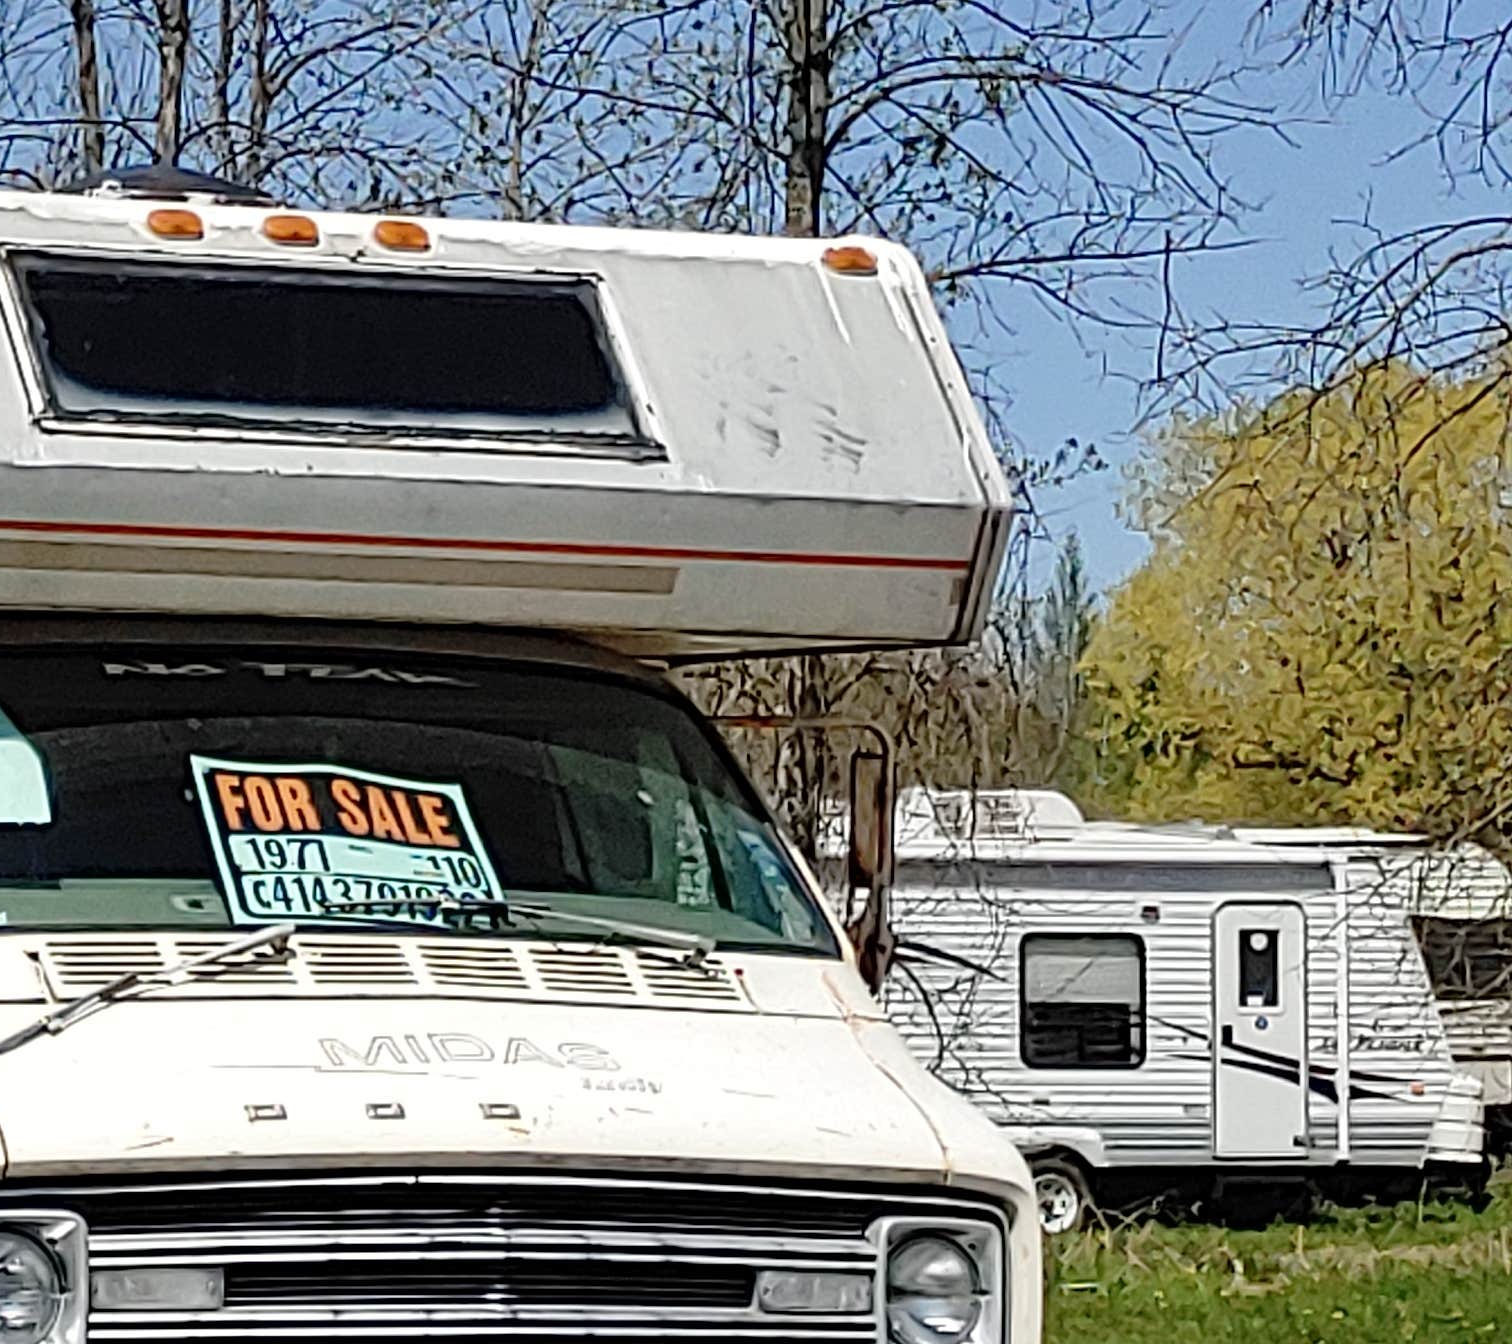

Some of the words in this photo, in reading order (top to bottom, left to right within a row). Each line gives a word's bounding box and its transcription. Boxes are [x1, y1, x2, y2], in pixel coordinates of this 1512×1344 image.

[214, 773, 322, 832] FOR
[331, 779, 461, 848] SALE
[318, 1032, 621, 1071] MIDAS
